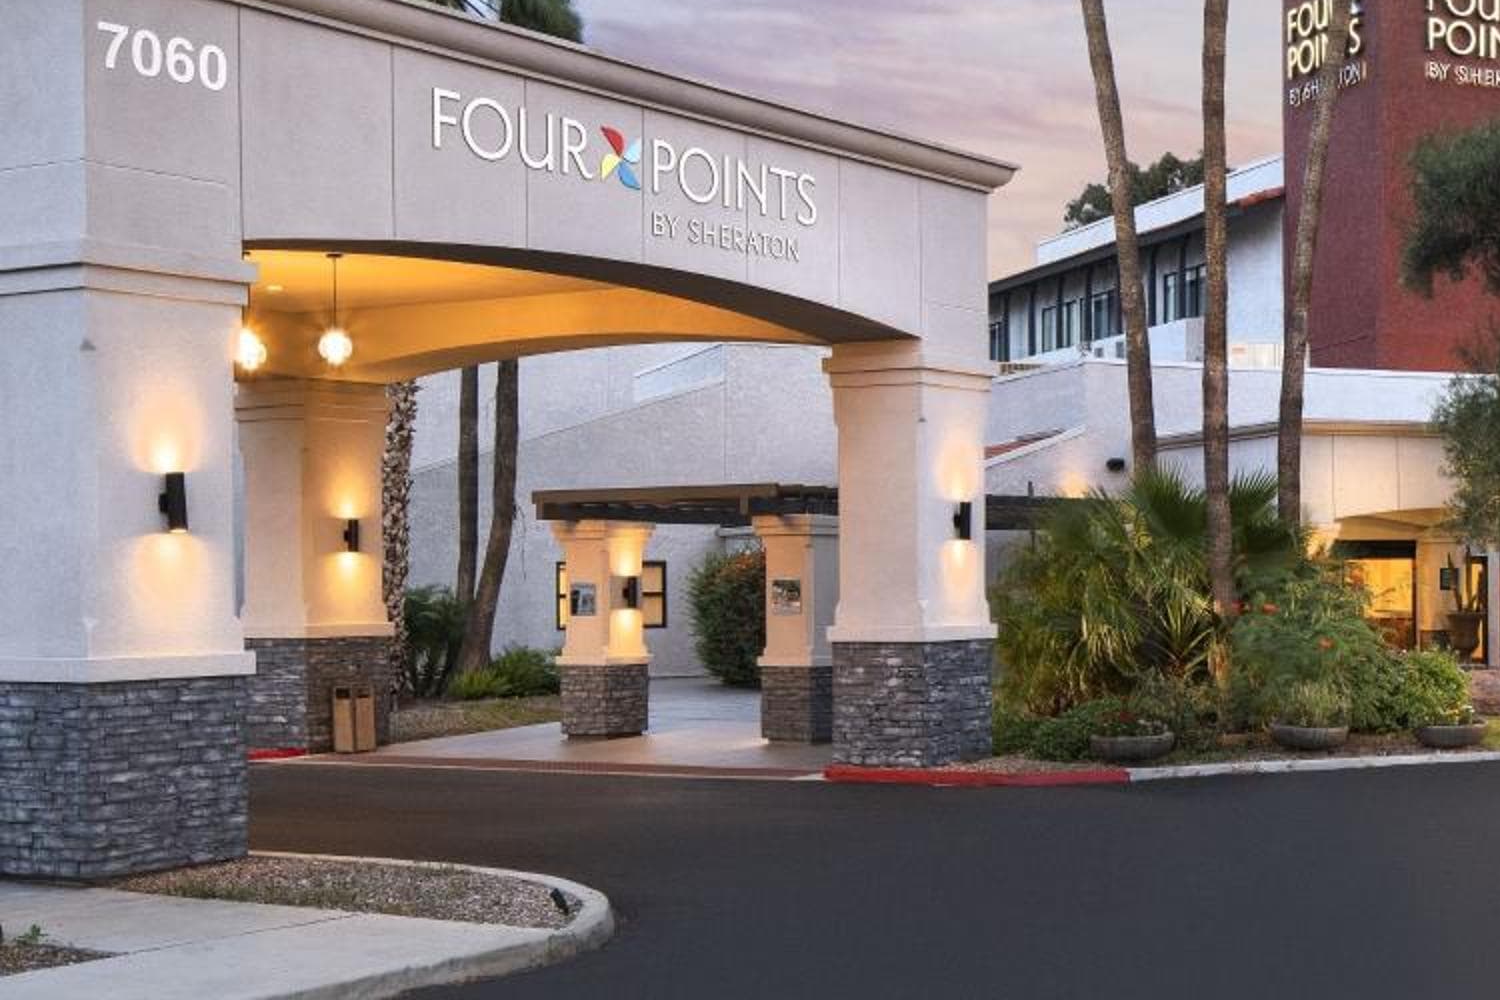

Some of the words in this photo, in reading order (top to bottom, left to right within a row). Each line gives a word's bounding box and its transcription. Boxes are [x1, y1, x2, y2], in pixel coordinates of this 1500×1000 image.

[98, 21, 227, 91] 7060
[1426, 61, 1450, 80] BY
[432, 87, 593, 181] FOUR
[652, 139, 818, 226] POINTS
[651, 211, 679, 238] BY
[688, 220, 801, 262] SHERATON
